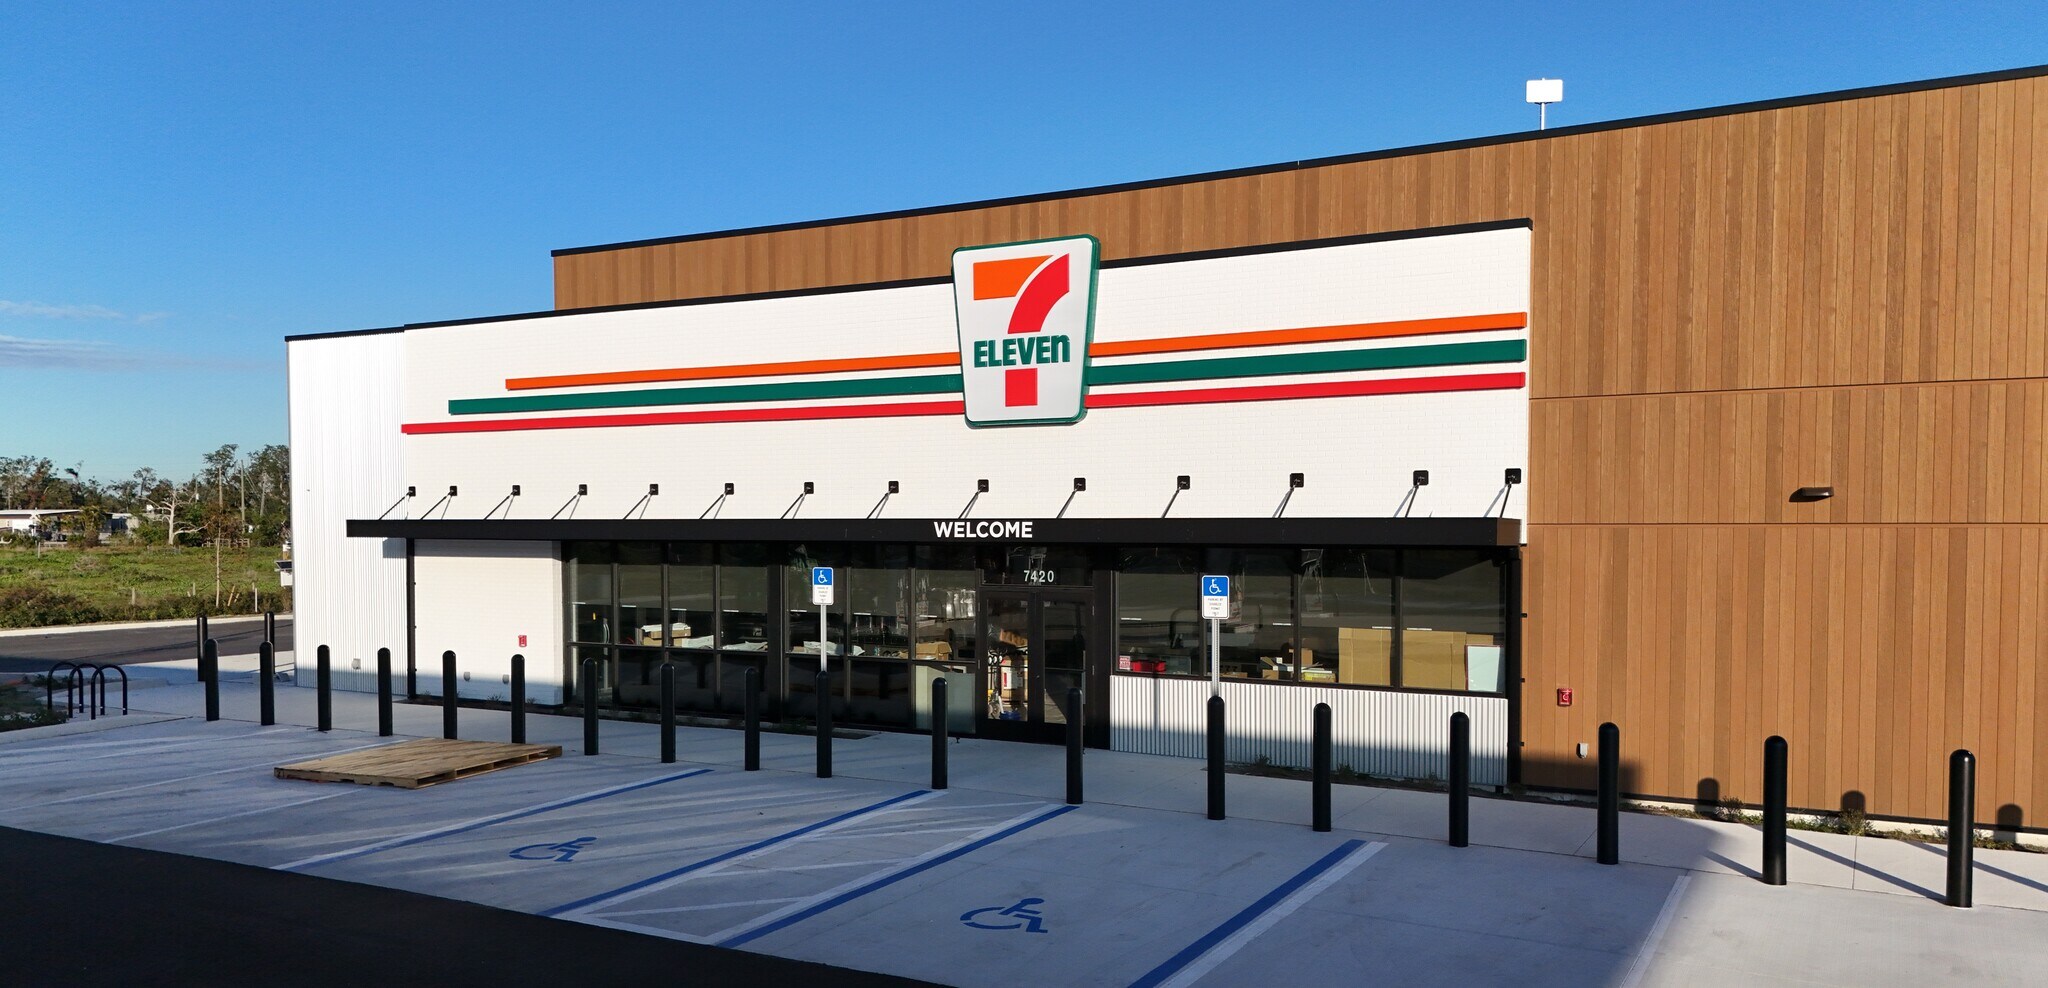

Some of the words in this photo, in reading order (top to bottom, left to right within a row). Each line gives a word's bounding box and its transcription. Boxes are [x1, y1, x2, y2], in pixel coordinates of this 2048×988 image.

[973, 253, 1070, 407] 7
[973, 334, 1071, 368] ELEVEn
[933, 521, 1033, 538] WELCOME
[1023, 570, 1055, 583] 7420
